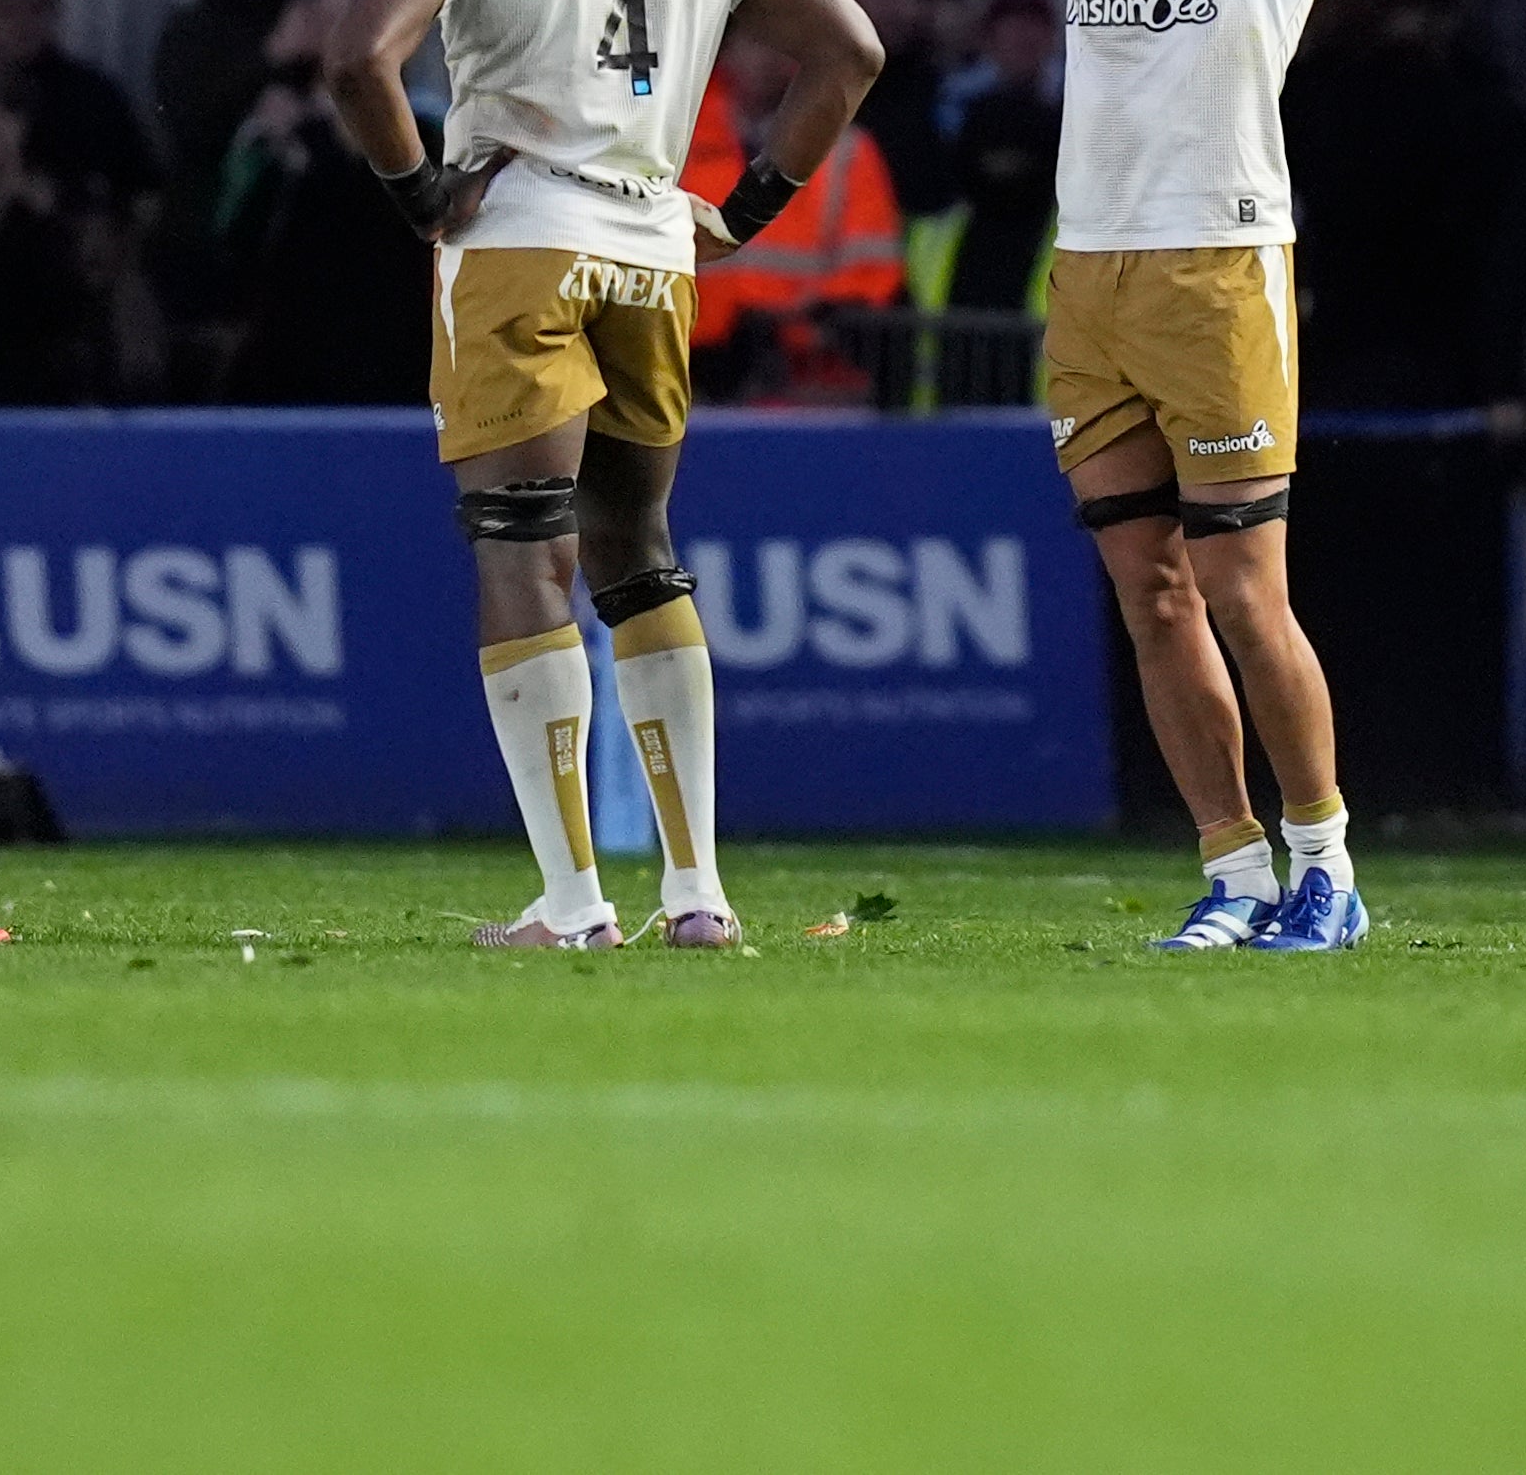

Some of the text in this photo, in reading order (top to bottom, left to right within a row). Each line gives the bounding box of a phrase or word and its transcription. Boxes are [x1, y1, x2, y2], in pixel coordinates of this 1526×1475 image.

[1187, 418, 1277, 456] PensionBee
[2, 543, 342, 678] USN
[692, 535, 1031, 668] USN
